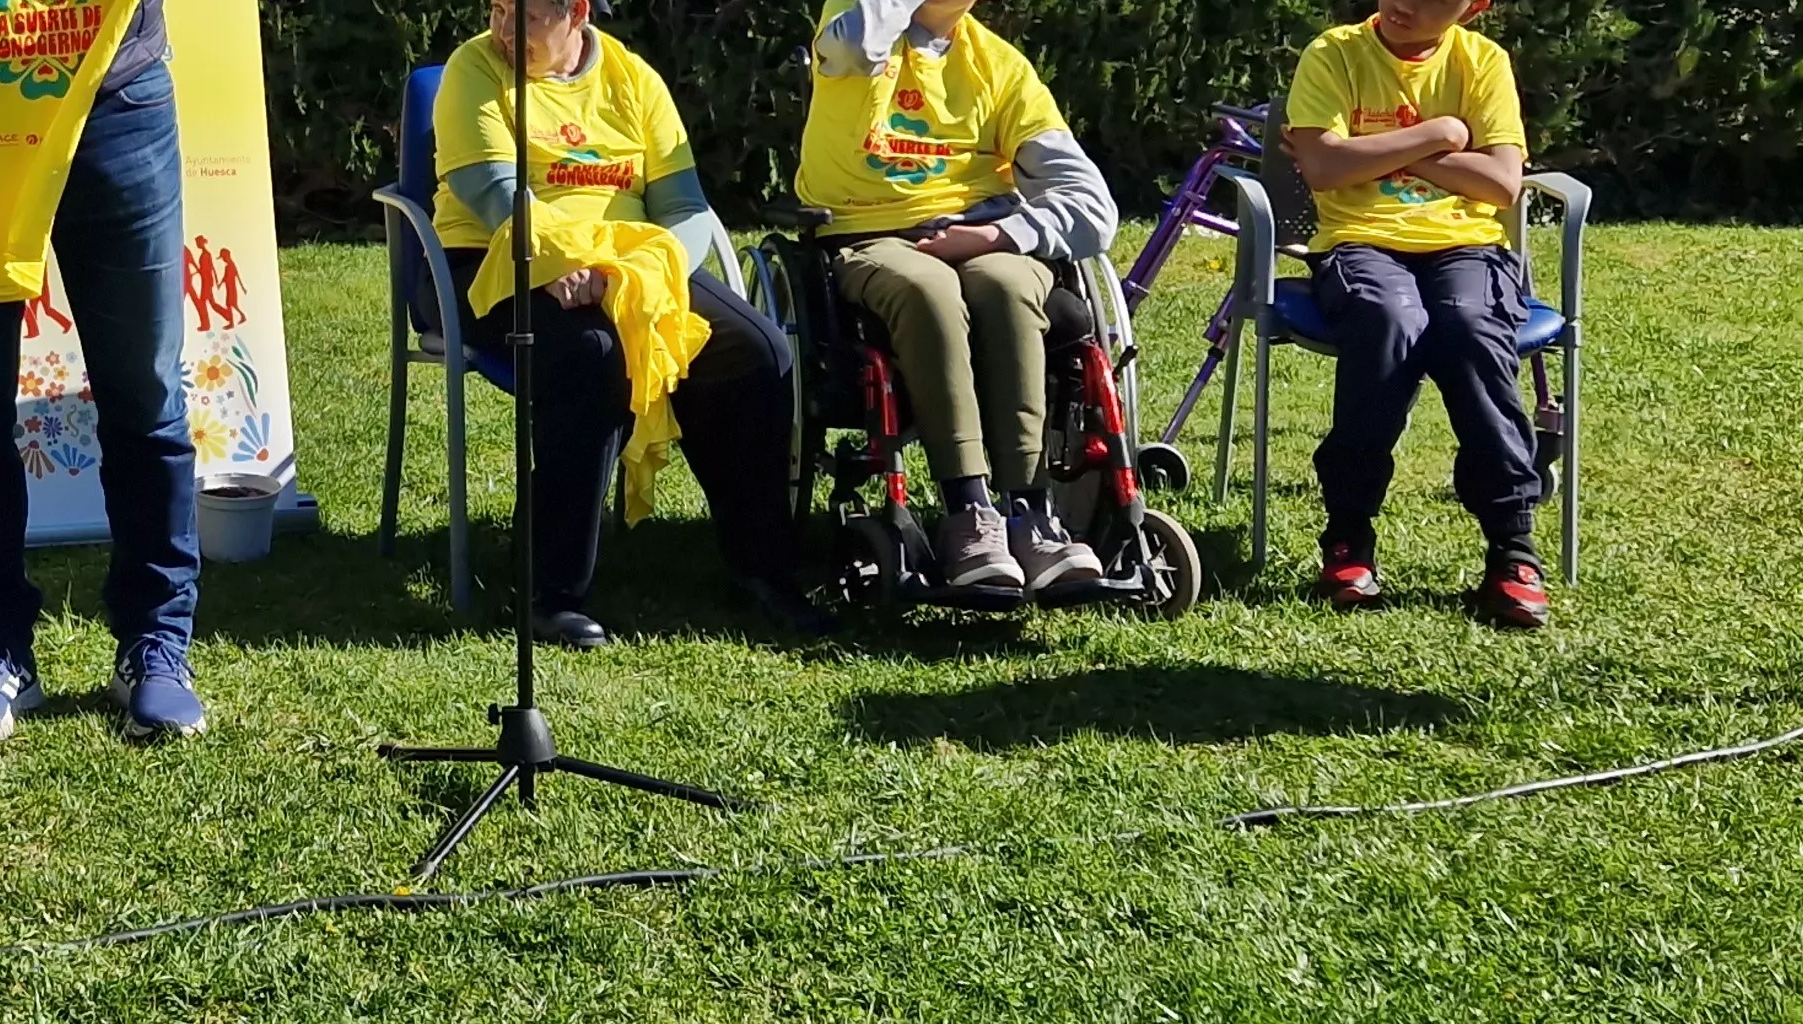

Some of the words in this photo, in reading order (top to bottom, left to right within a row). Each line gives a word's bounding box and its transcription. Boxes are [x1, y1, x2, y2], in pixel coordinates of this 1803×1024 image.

[13, 7, 78, 35] SUERTE
[82, 5, 102, 28] DE
[200, 167, 237, 177] Huesca
